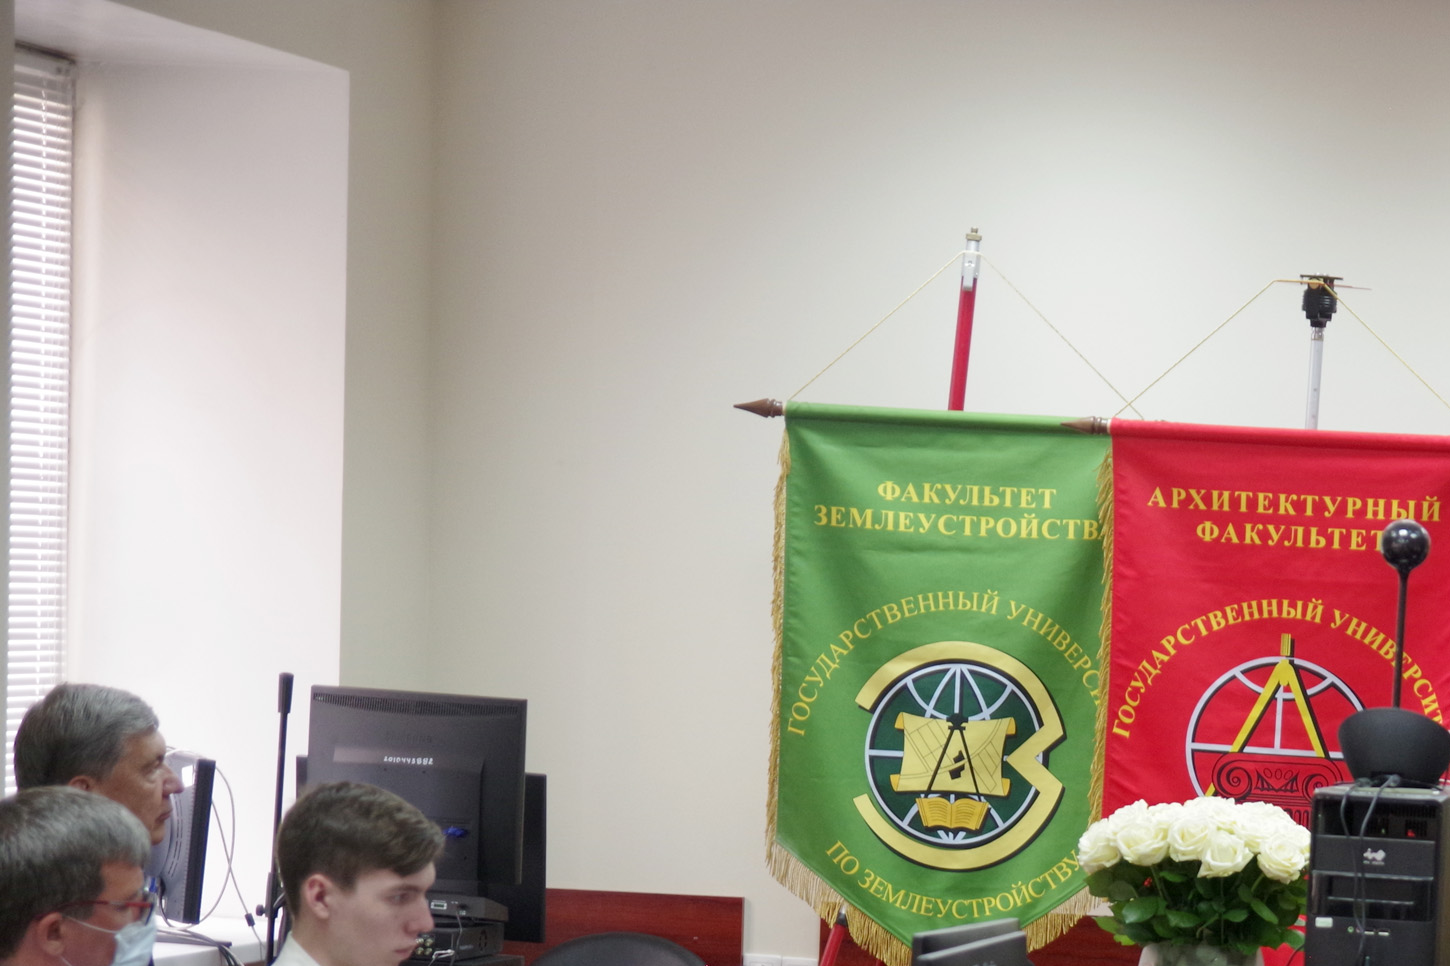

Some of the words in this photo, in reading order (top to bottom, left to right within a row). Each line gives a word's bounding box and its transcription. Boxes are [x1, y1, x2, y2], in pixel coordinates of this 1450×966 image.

[814, 505, 1102, 540] ЗЕМЛЕУСТРОЙСТВ
[877, 481, 1057, 509] ФАКУЛЬТЕТ
[1147, 486, 1441, 522] АРХИТЕКТУРНЫЙ
[787, 589, 1001, 737] ГОСУДАРСТВЕННЫЙ
[1112, 598, 1324, 738] ГОСУДАРСТВЕННЫЙ
[825, 840, 860, 876] ПО
[857, 849, 1080, 920] ЗЕМЛЕУСТРОЙСТВУ
